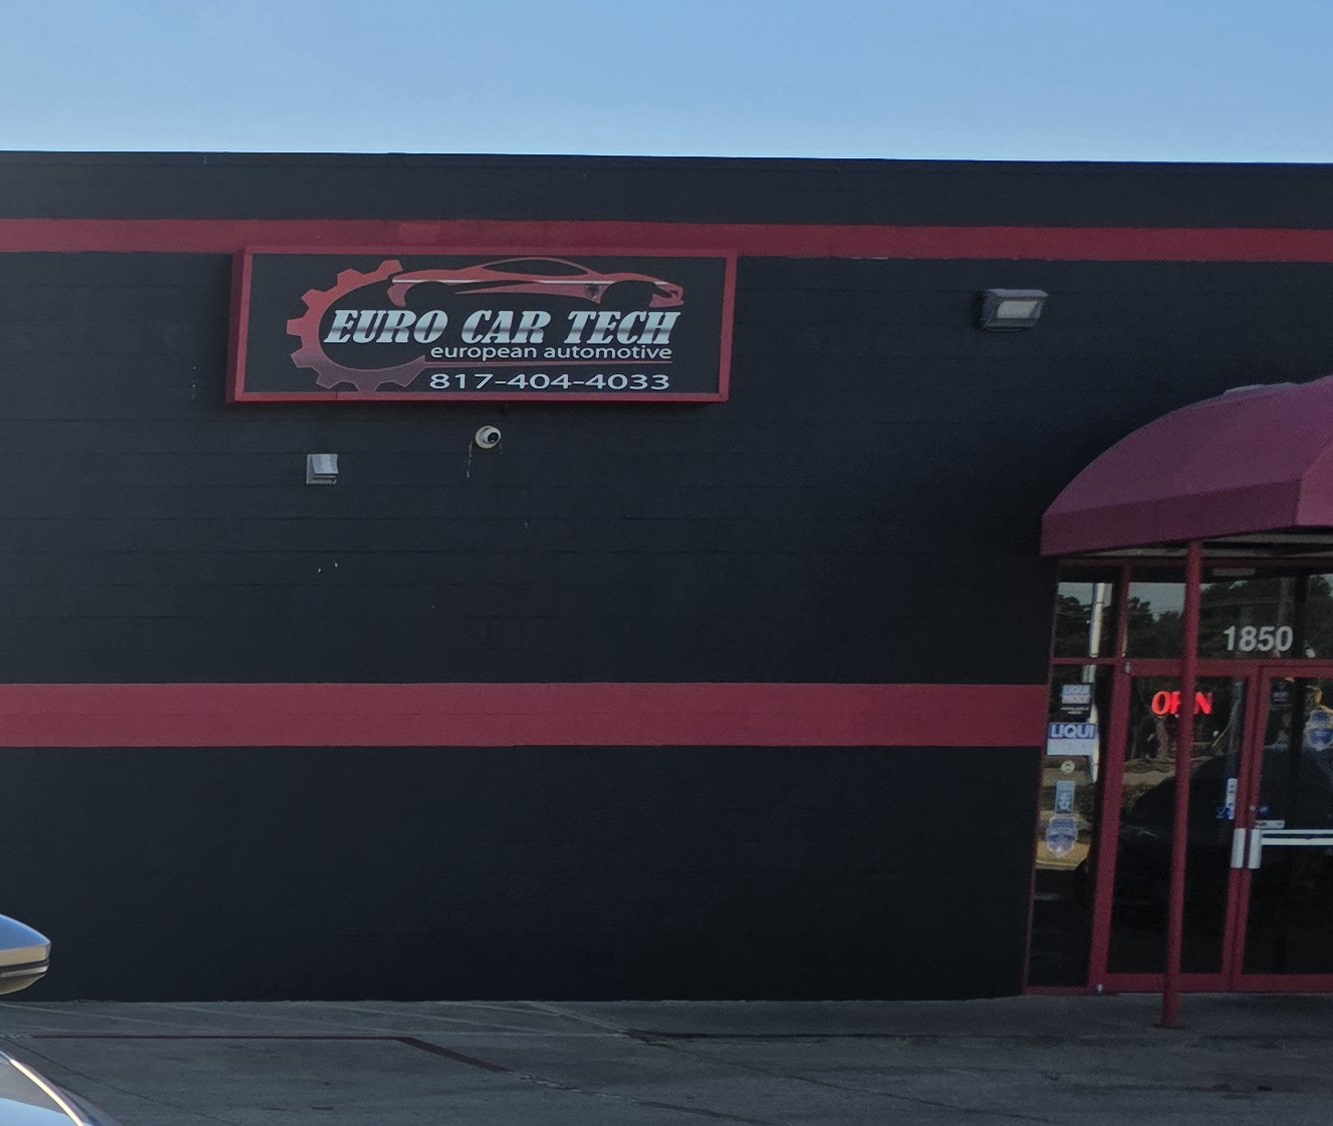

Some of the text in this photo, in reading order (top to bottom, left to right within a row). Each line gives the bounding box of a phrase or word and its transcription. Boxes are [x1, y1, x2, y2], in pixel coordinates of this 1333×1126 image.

[323, 309, 681, 344] EURO CAR TECH
[430, 345, 672, 361] european automotive
[429, 373, 670, 390] 817-404-4033
[1223, 625, 1294, 651] 1850
[1050, 723, 1095, 738] LIQUI
